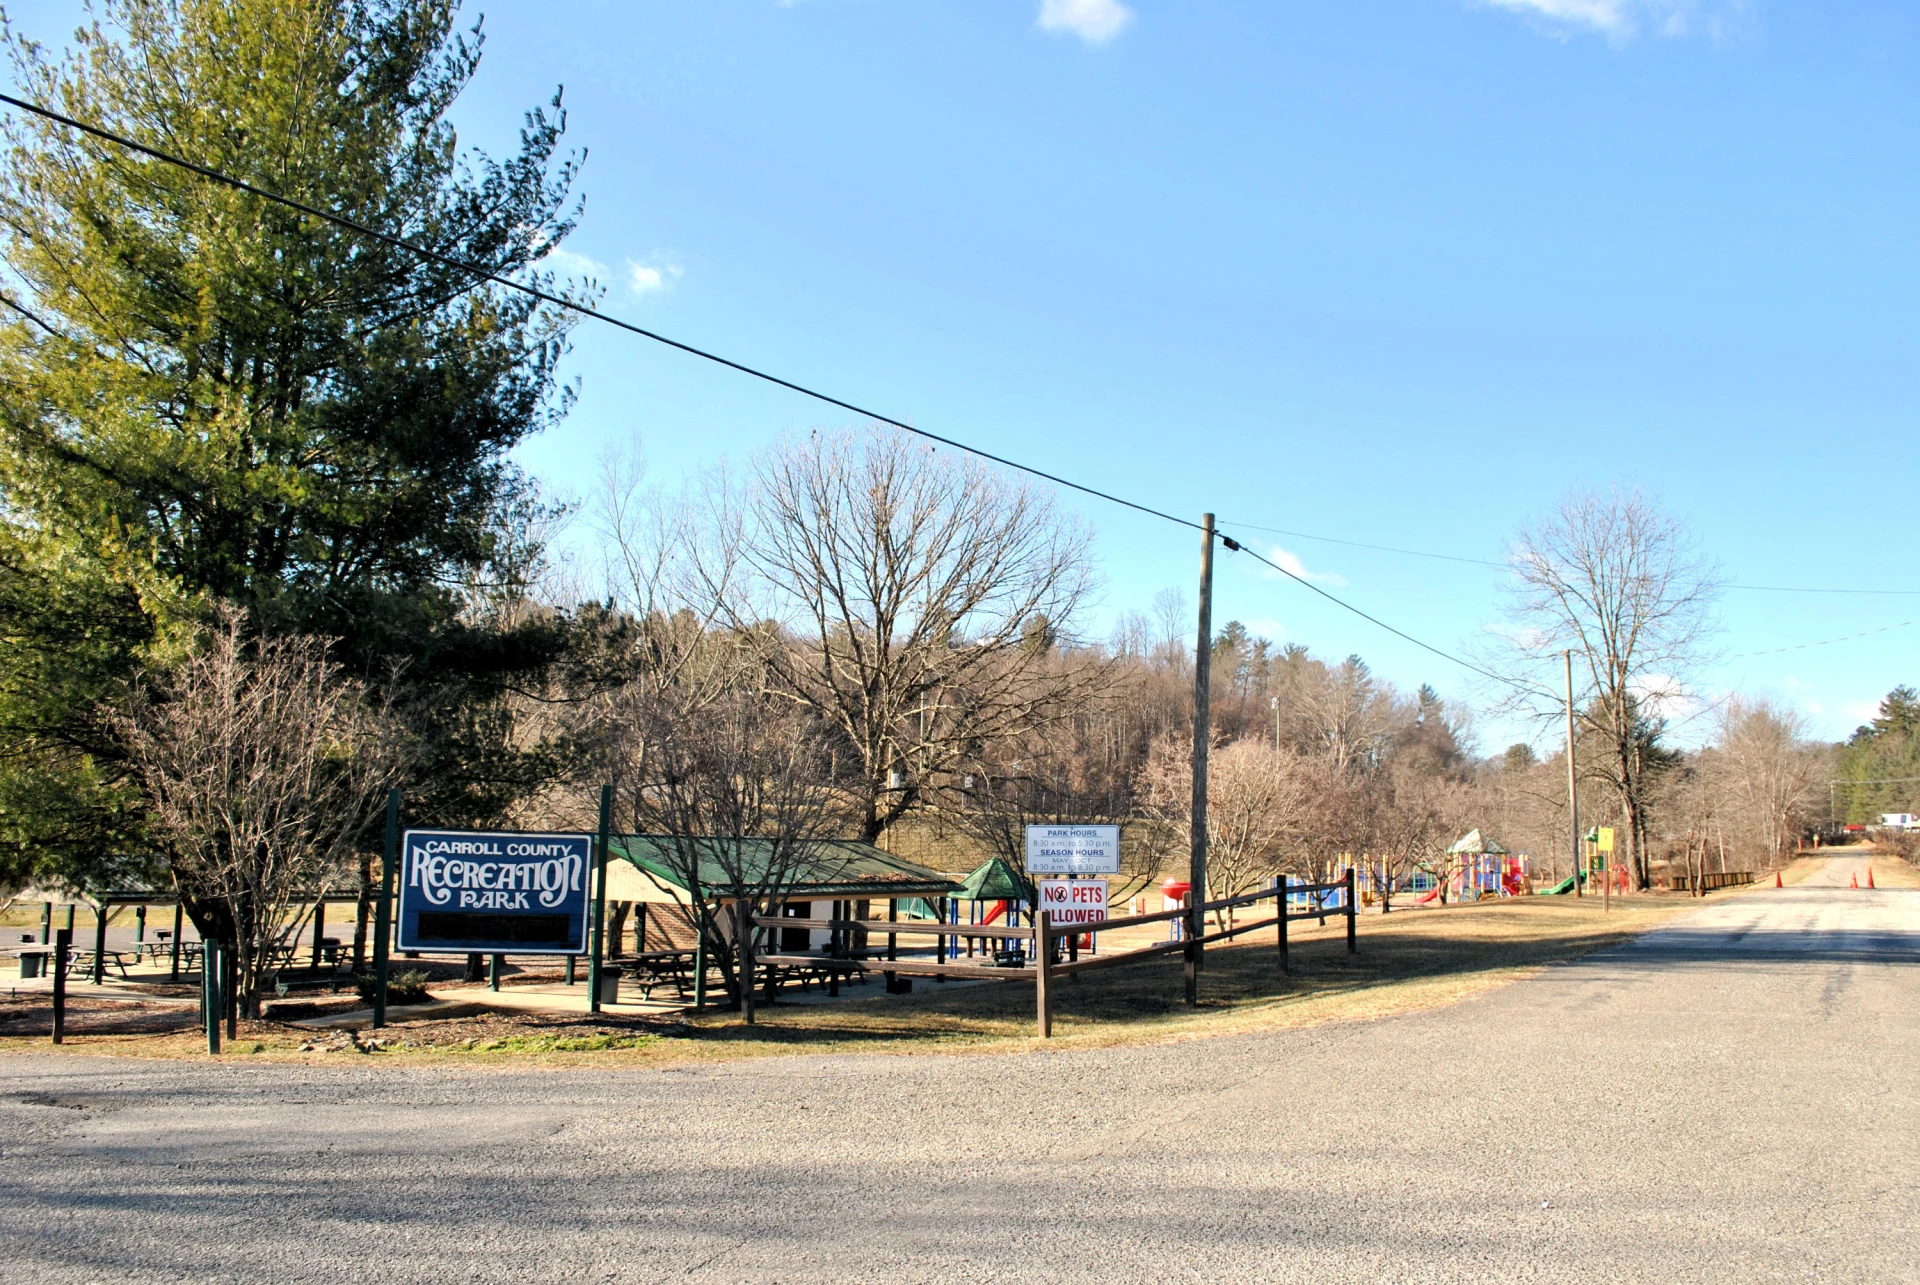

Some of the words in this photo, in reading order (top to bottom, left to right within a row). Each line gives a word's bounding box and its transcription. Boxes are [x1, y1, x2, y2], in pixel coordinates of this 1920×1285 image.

[425, 840, 503, 855] CARROLL
[506, 843, 573, 857] COUNTY
[409, 845, 582, 908] RECREATION
[459, 890, 531, 909] PARK
[1072, 887, 1102, 903] PETS
[1046, 909, 1104, 922] LLOWED
